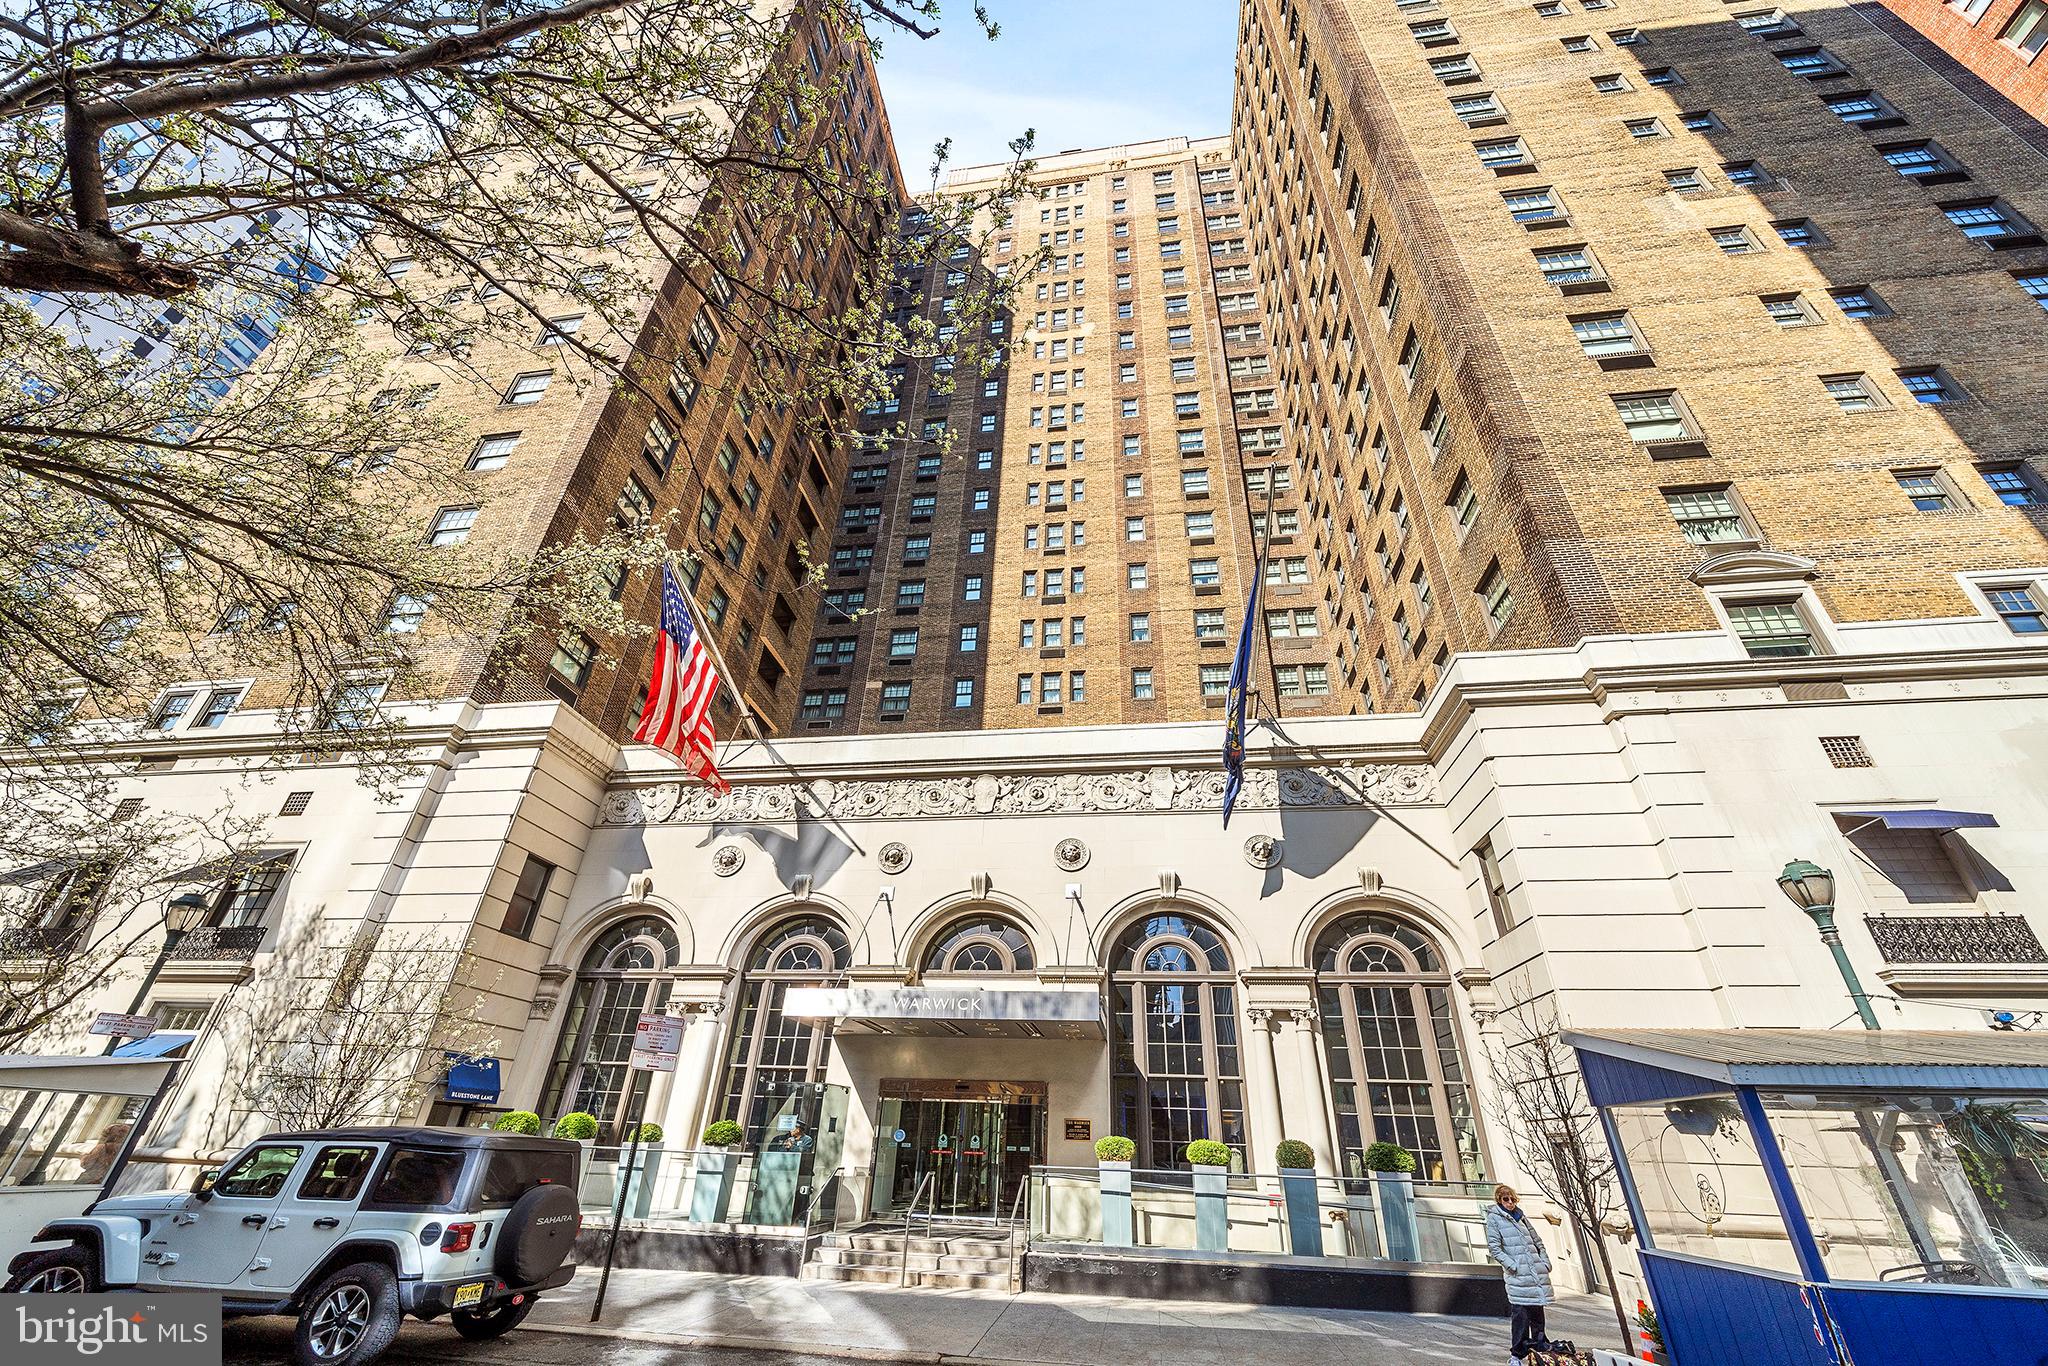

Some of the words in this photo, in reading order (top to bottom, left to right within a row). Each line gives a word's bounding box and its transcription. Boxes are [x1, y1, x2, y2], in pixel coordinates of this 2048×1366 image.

[893, 998, 981, 1011] WARWICK
[639, 1023, 648, 1031] NO
[536, 1214, 573, 1225] SAHARA
